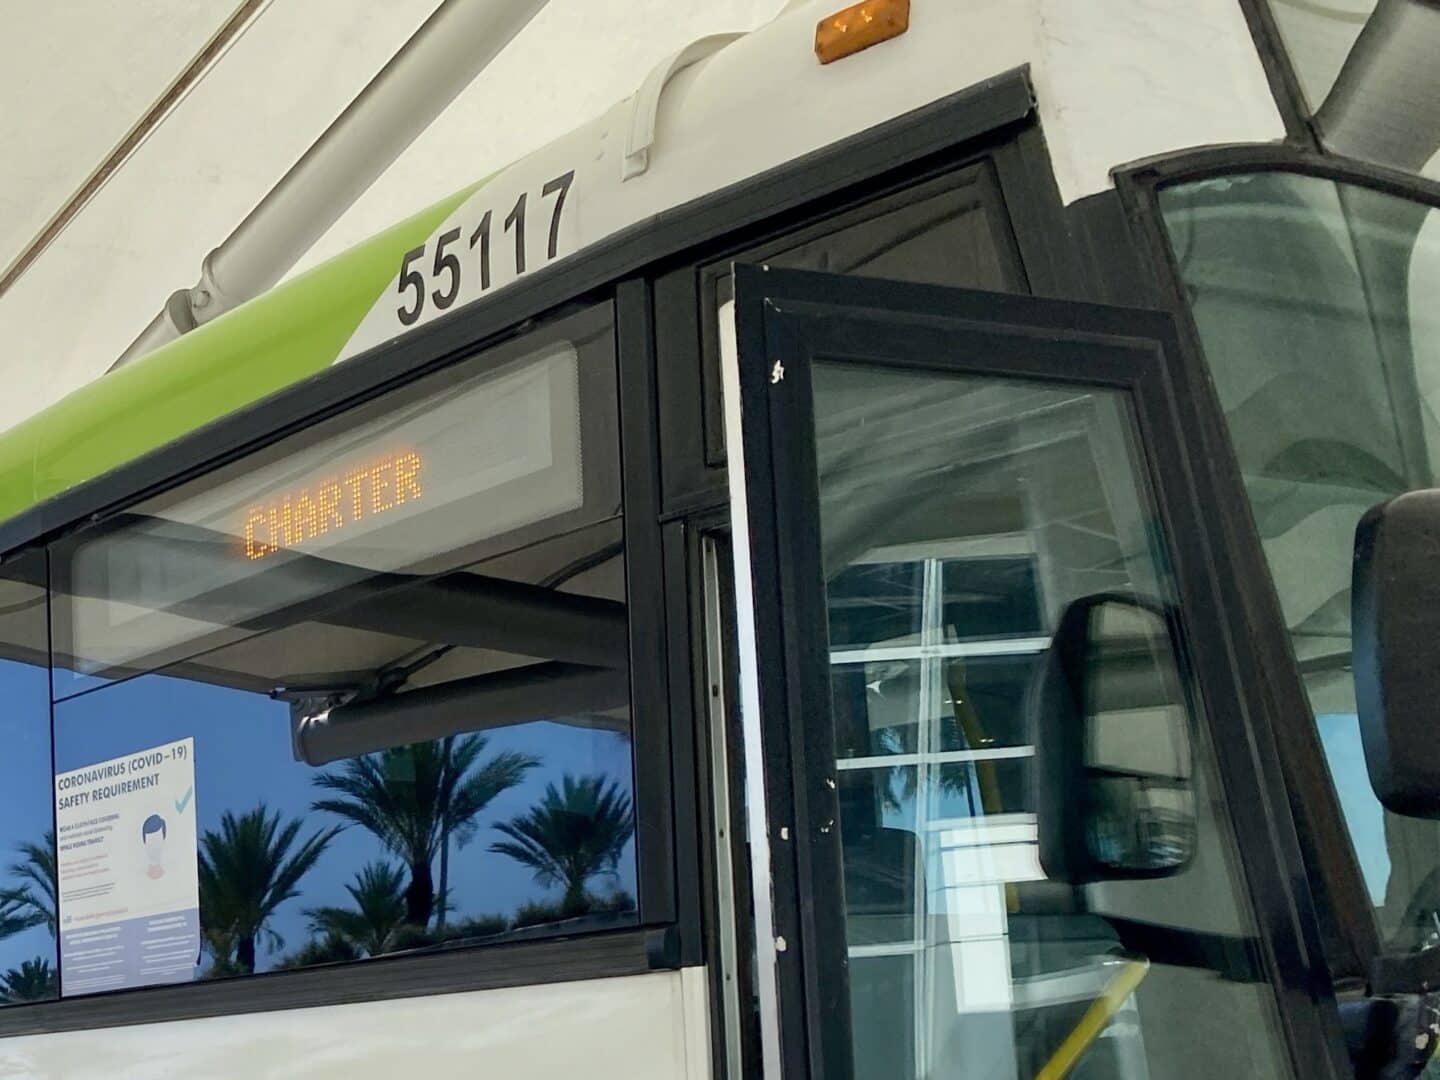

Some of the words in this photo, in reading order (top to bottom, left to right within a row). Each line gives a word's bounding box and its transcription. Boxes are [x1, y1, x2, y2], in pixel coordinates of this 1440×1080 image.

[396, 170, 575, 327] 55117
[244, 451, 423, 560] CHARTER
[58, 762, 126, 791] CORONAVIRUS
[58, 792, 90, 811] SAFETY
[92, 773, 160, 801] REQUIREMENT
